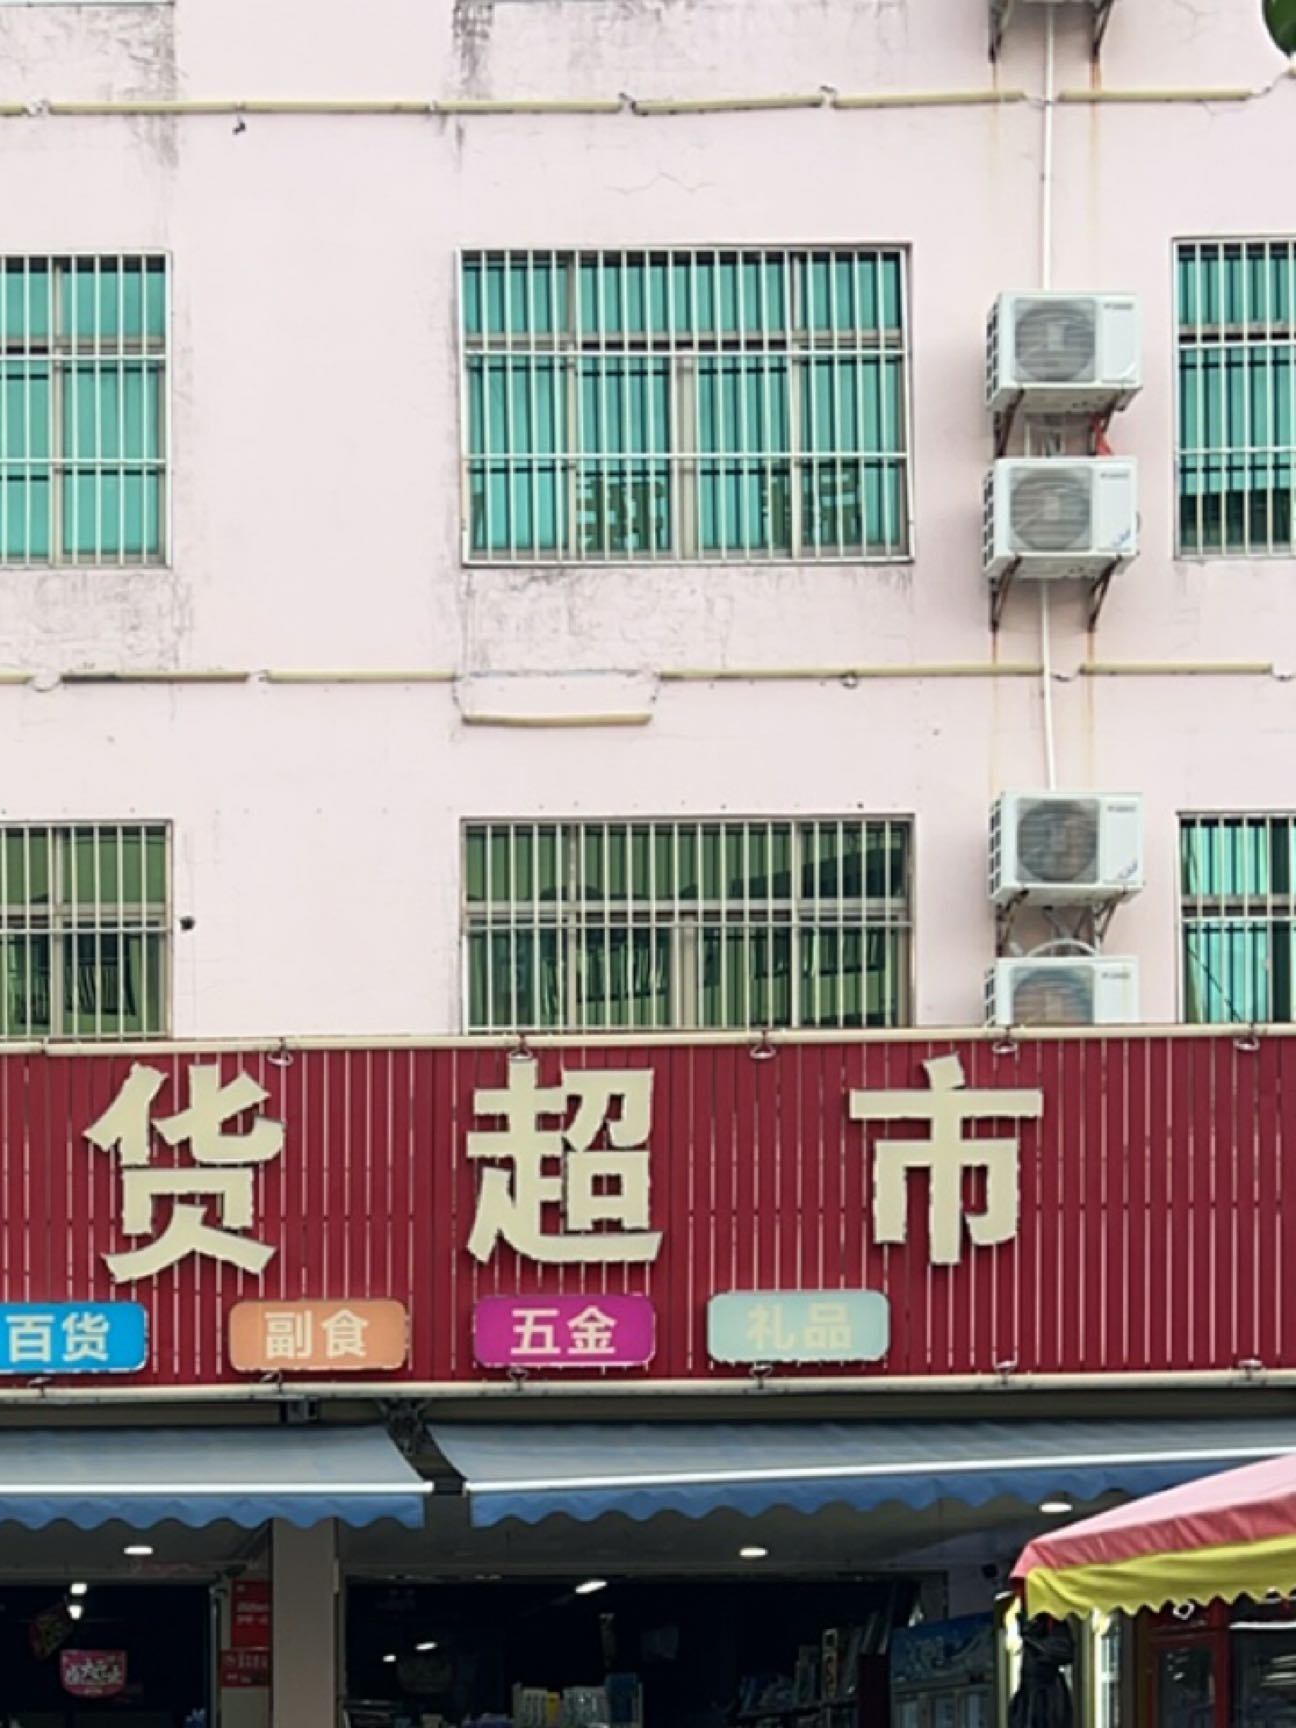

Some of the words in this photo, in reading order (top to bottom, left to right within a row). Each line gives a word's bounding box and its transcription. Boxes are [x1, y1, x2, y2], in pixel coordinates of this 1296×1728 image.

[5, 1311, 112, 1363] 百货
[263, 1308, 370, 1358] 副食
[510, 1306, 617, 1356] 五金
[747, 1303, 853, 1353] 礼品
